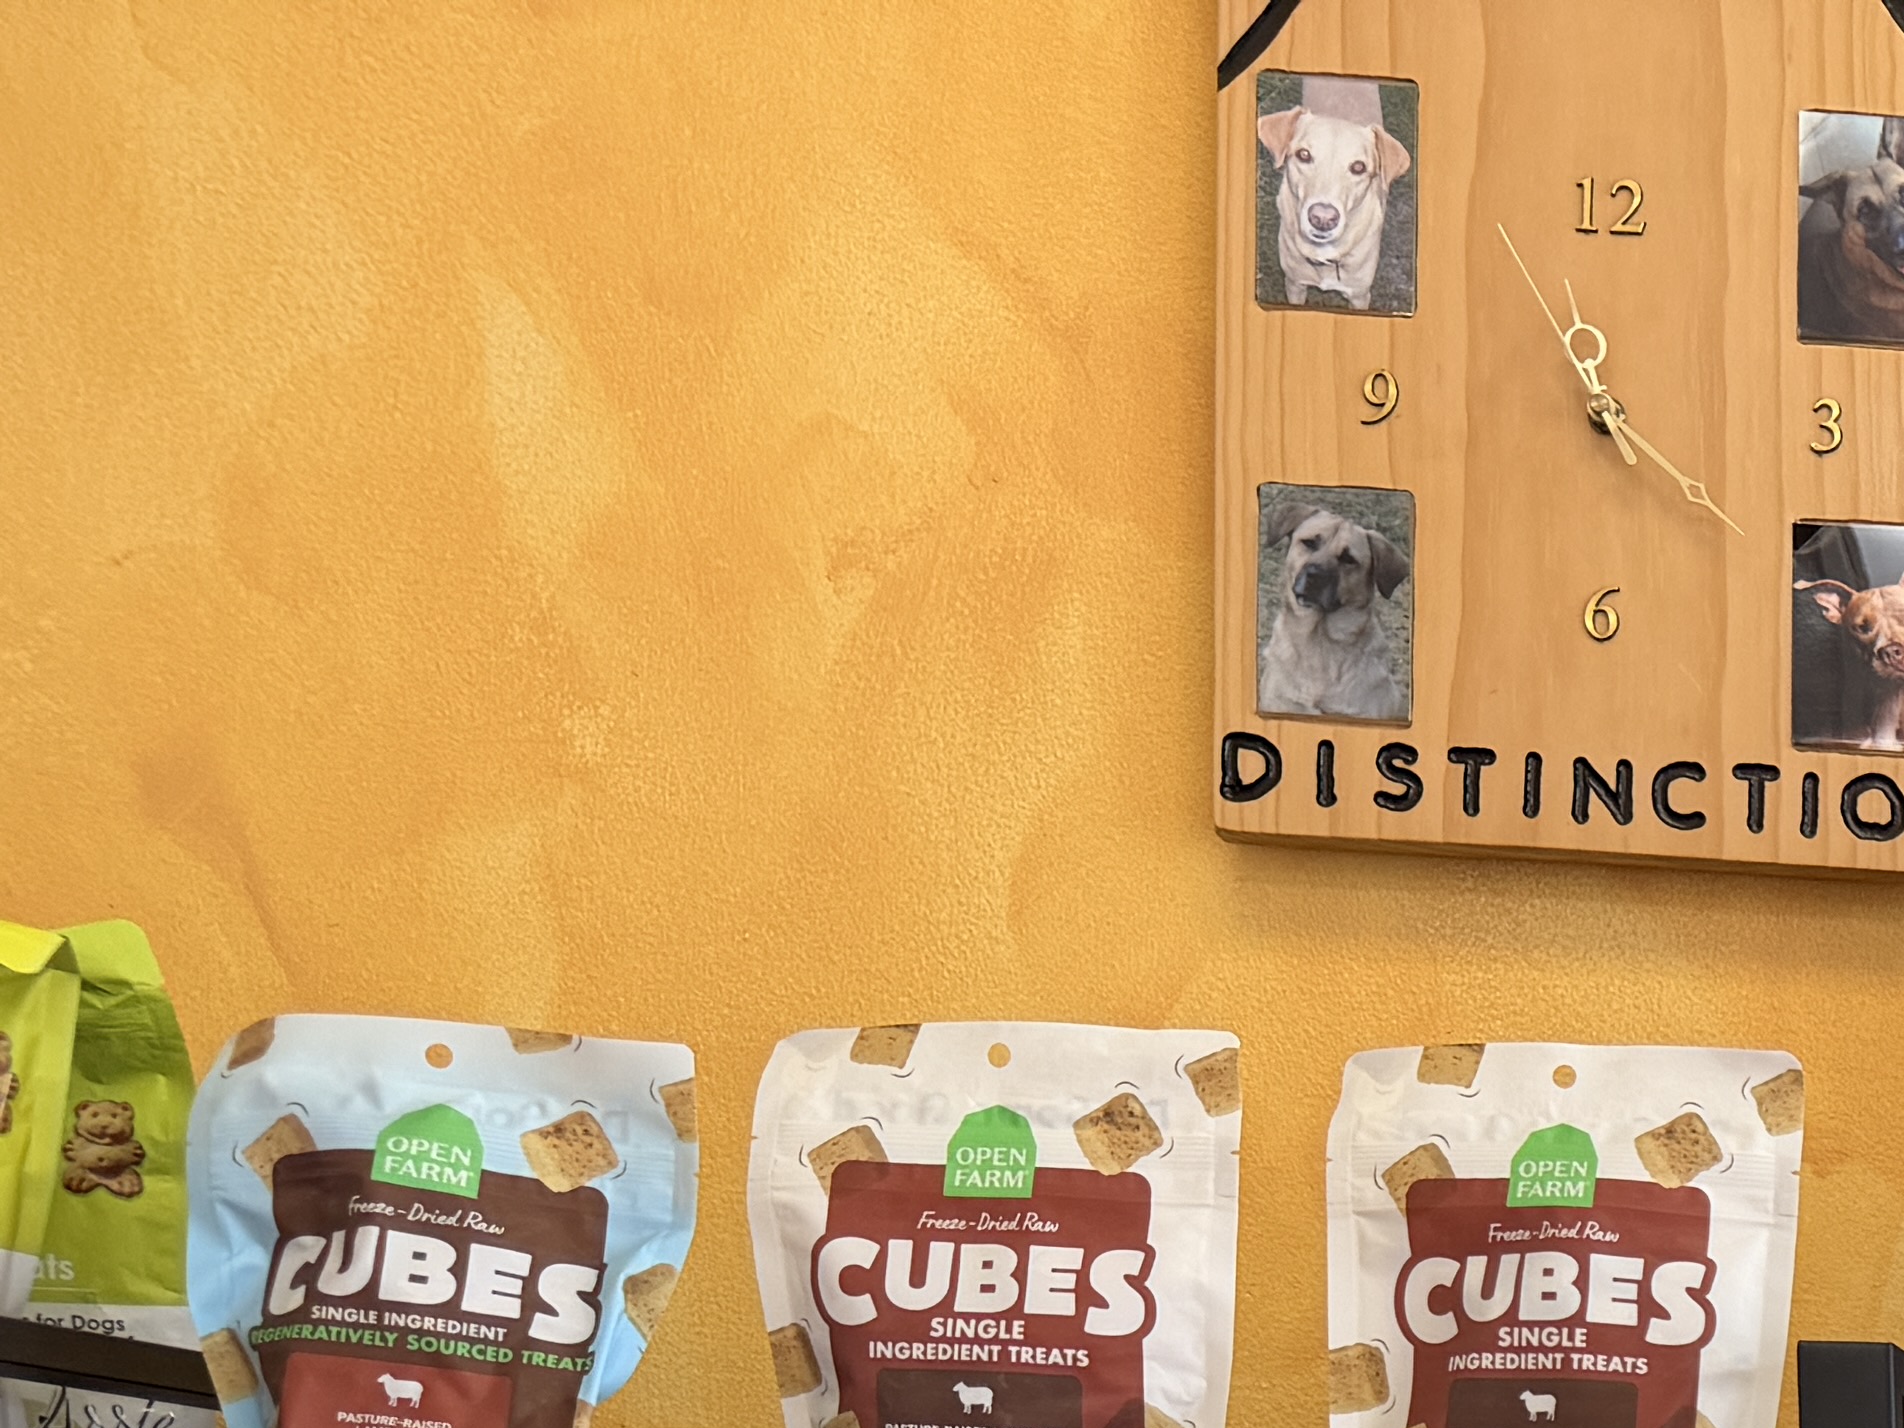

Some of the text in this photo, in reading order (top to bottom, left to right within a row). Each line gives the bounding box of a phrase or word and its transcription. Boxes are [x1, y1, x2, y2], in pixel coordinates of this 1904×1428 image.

[1574, 177, 1646, 236] 12
[1361, 369, 1399, 425] 9
[1810, 399, 1843, 454] 3
[1583, 586, 1620, 641] 6
[387, 1135, 473, 1164] OPEN
[269, 1225, 603, 1344] CUBES
[817, 1237, 1150, 1337] CUBES
[1404, 1251, 1707, 1344] CUBES
[310, 1304, 507, 1342] SINGLE INGREDIENT
[929, 1318, 1026, 1339] SINGLE
[1497, 1327, 1588, 1346] SINGLE
[406, 1333, 513, 1363] SOURCED
[520, 1350, 595, 1373] TREATS
[868, 1342, 1089, 1368] INGREDIENT TREATS
